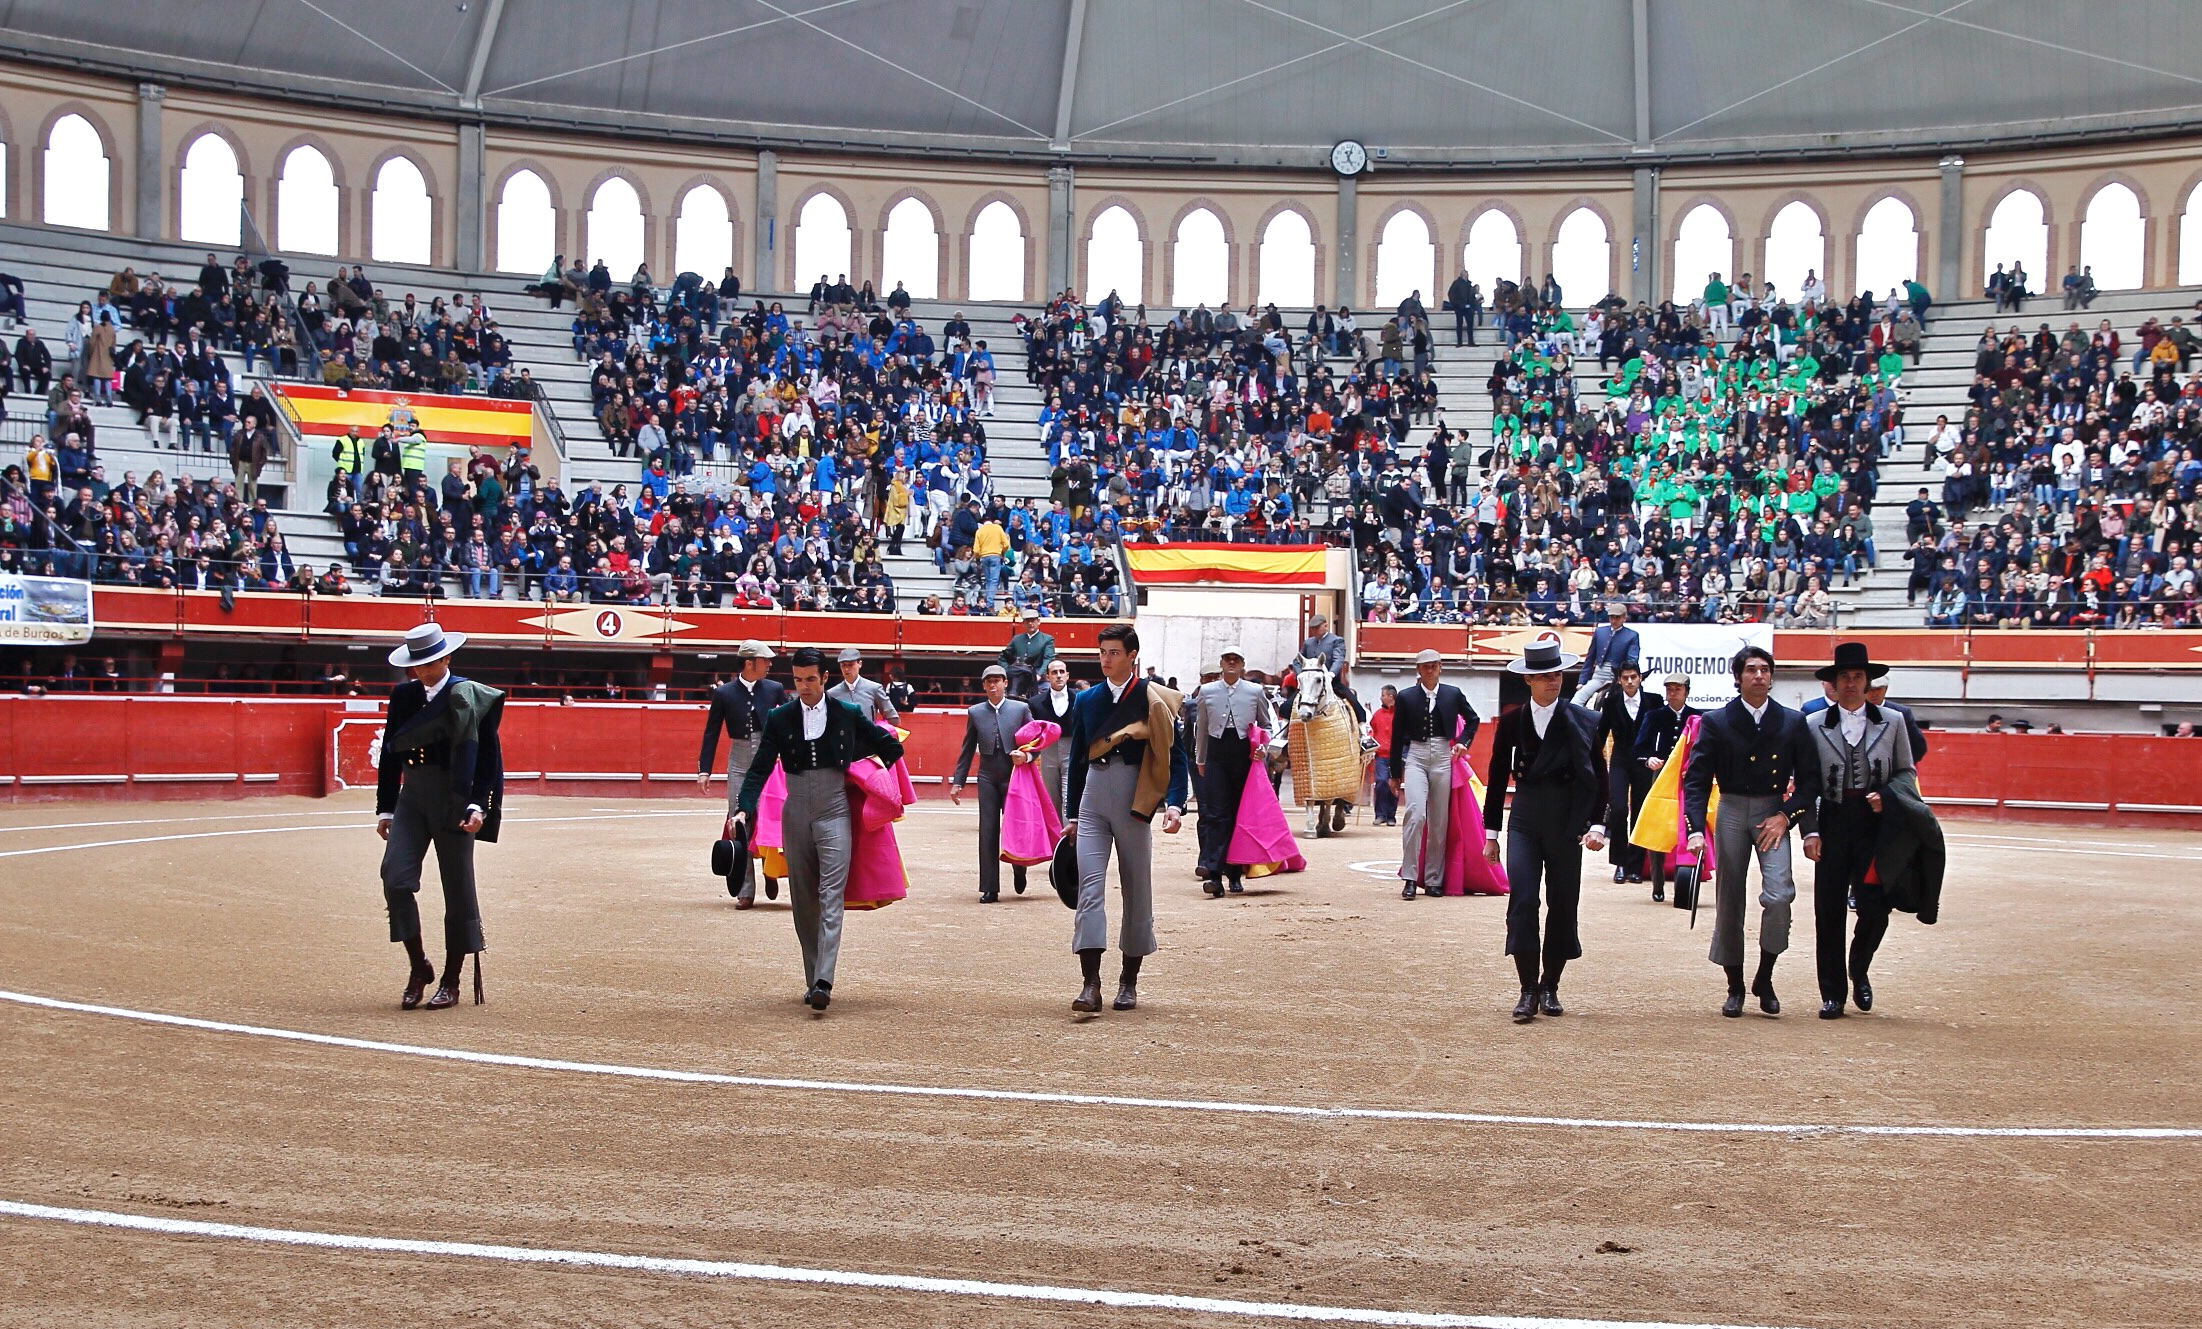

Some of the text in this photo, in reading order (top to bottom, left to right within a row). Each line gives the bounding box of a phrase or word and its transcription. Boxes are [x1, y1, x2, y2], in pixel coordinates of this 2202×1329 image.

[601, 613, 616, 634] 4
[5, 627, 64, 641] de Burgos
